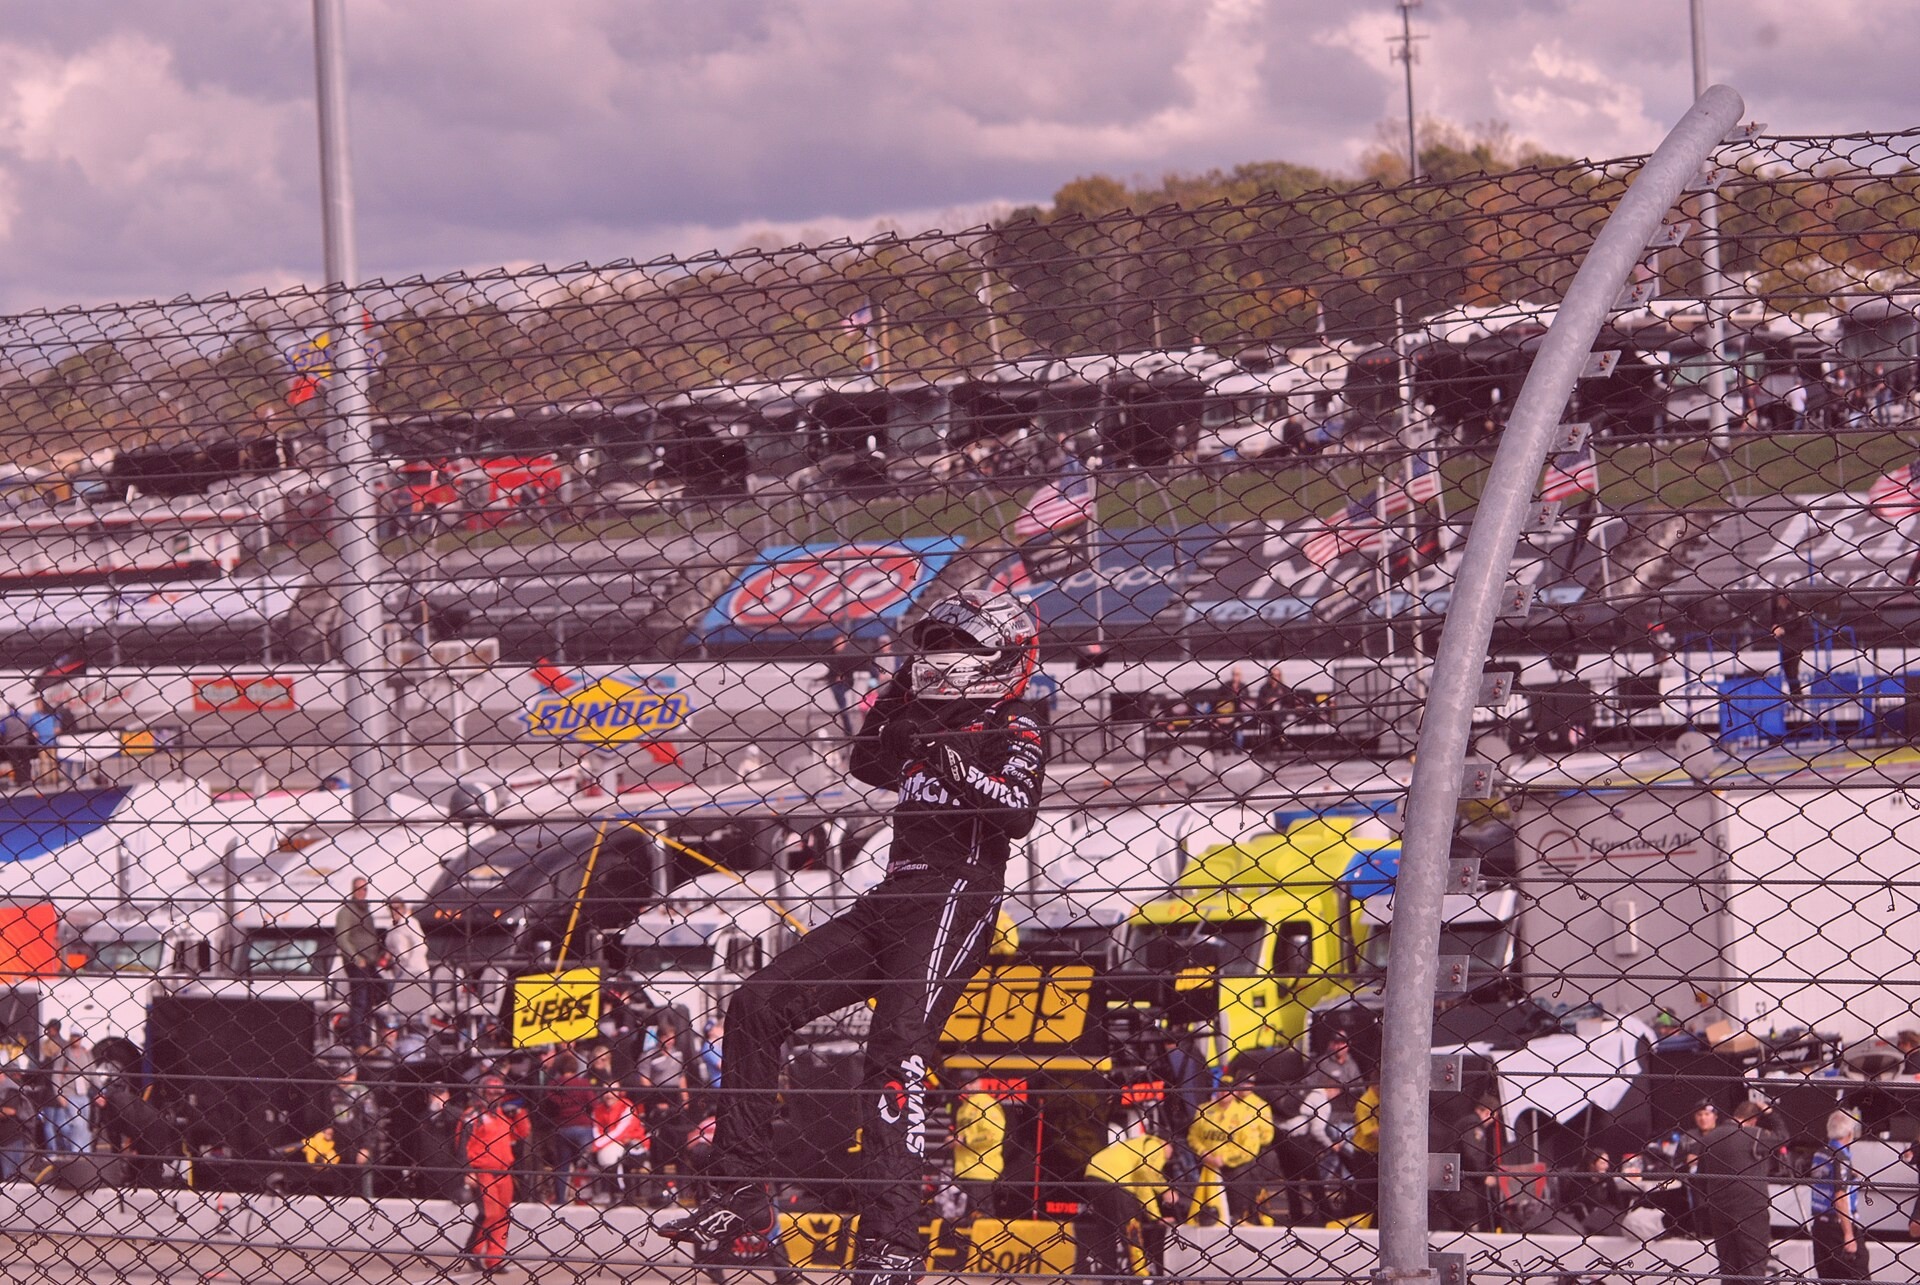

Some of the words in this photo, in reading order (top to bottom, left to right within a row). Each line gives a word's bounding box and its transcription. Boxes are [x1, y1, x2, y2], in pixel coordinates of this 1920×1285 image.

[741, 557, 902, 623] STP
[536, 697, 685, 731] SUNOCO
[1590, 835, 1666, 853] Forward
[520, 993, 593, 1028] JEGS
[938, 965, 1096, 1043] EGS
